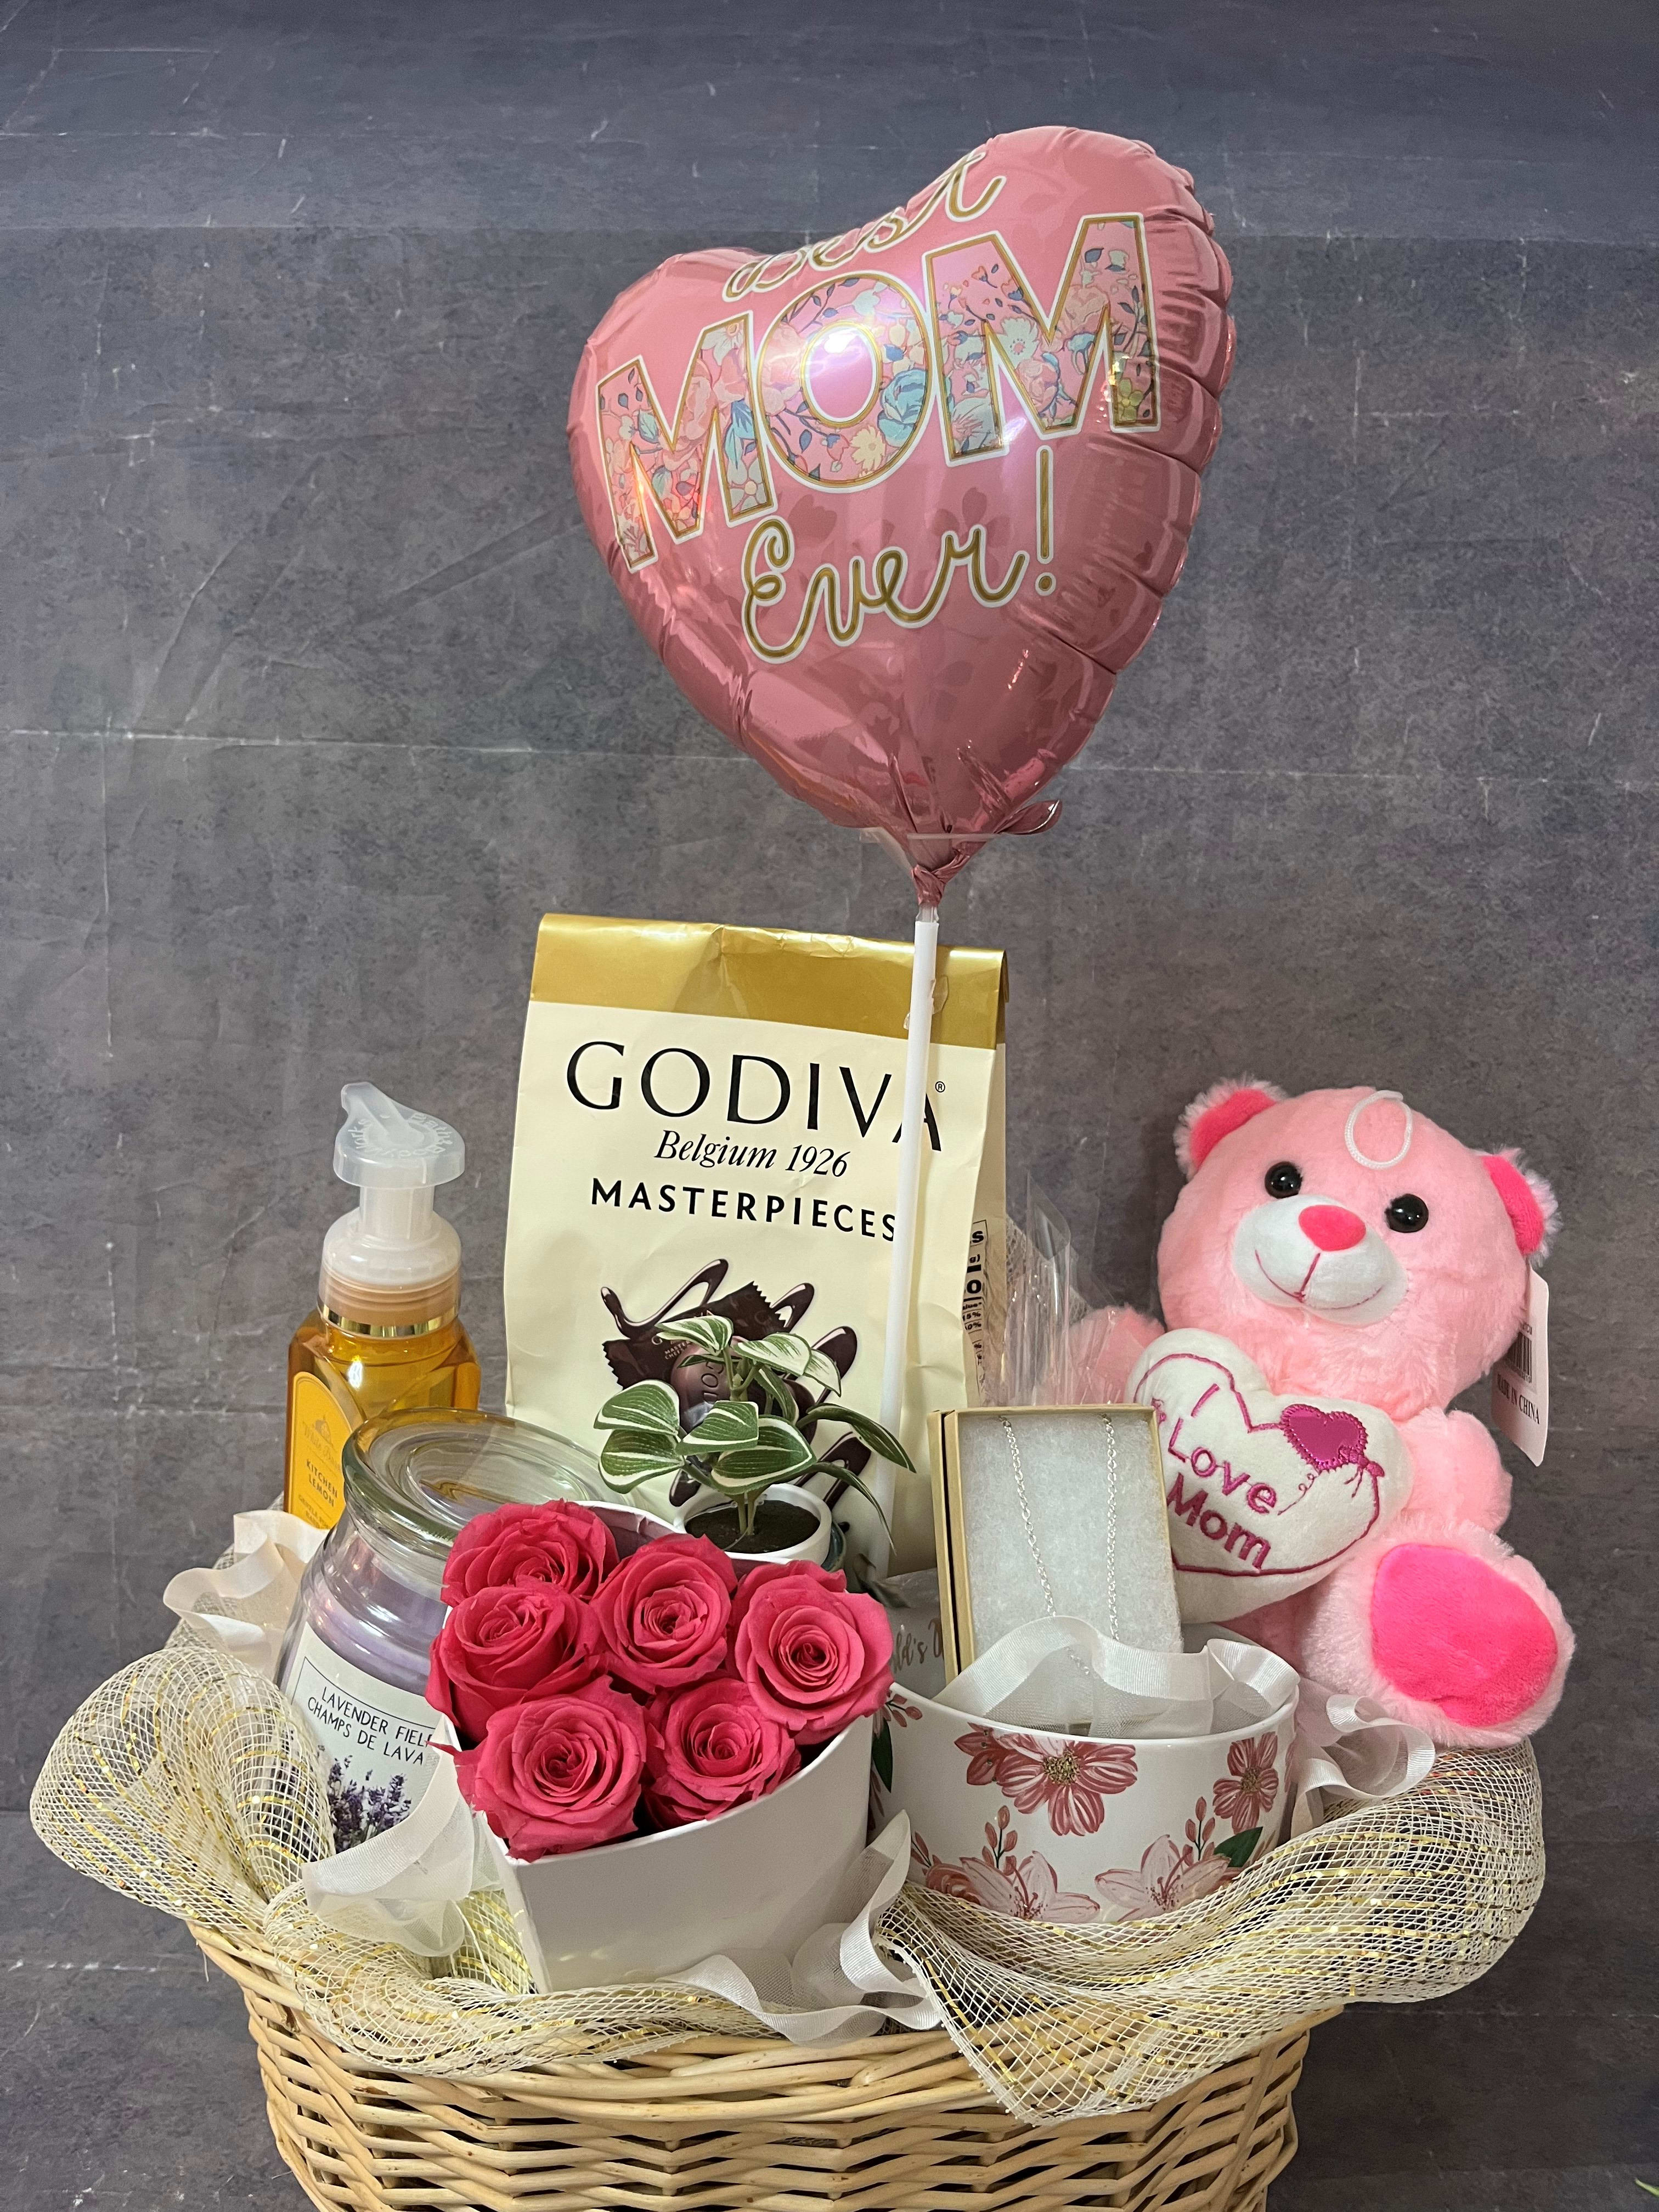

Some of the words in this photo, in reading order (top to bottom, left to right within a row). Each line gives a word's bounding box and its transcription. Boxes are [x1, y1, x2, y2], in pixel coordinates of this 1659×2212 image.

[595, 213, 1161, 573] MOM
[741, 444, 1057, 663] Ever!
[654, 1130, 777, 1169] Belgium
[785, 1144, 851, 1177] 1926
[591, 1177, 895, 1242] MASTERPIECES
[1190, 1383, 1220, 1417] I
[1511, 1386, 1517, 1406] IN
[1519, 1394, 1539, 1425] CHINA
[306, 1459, 338, 1499] KITCHEN
[308, 1474, 334, 1508] LEMON
[1167, 1417, 1278, 1514] Love
[1166, 1471, 1272, 1571] Mom
[307, 1697, 352, 1738] CHAMPS
[357, 1730, 377, 1751] DE
[321, 1686, 388, 1735] LAVENDER
